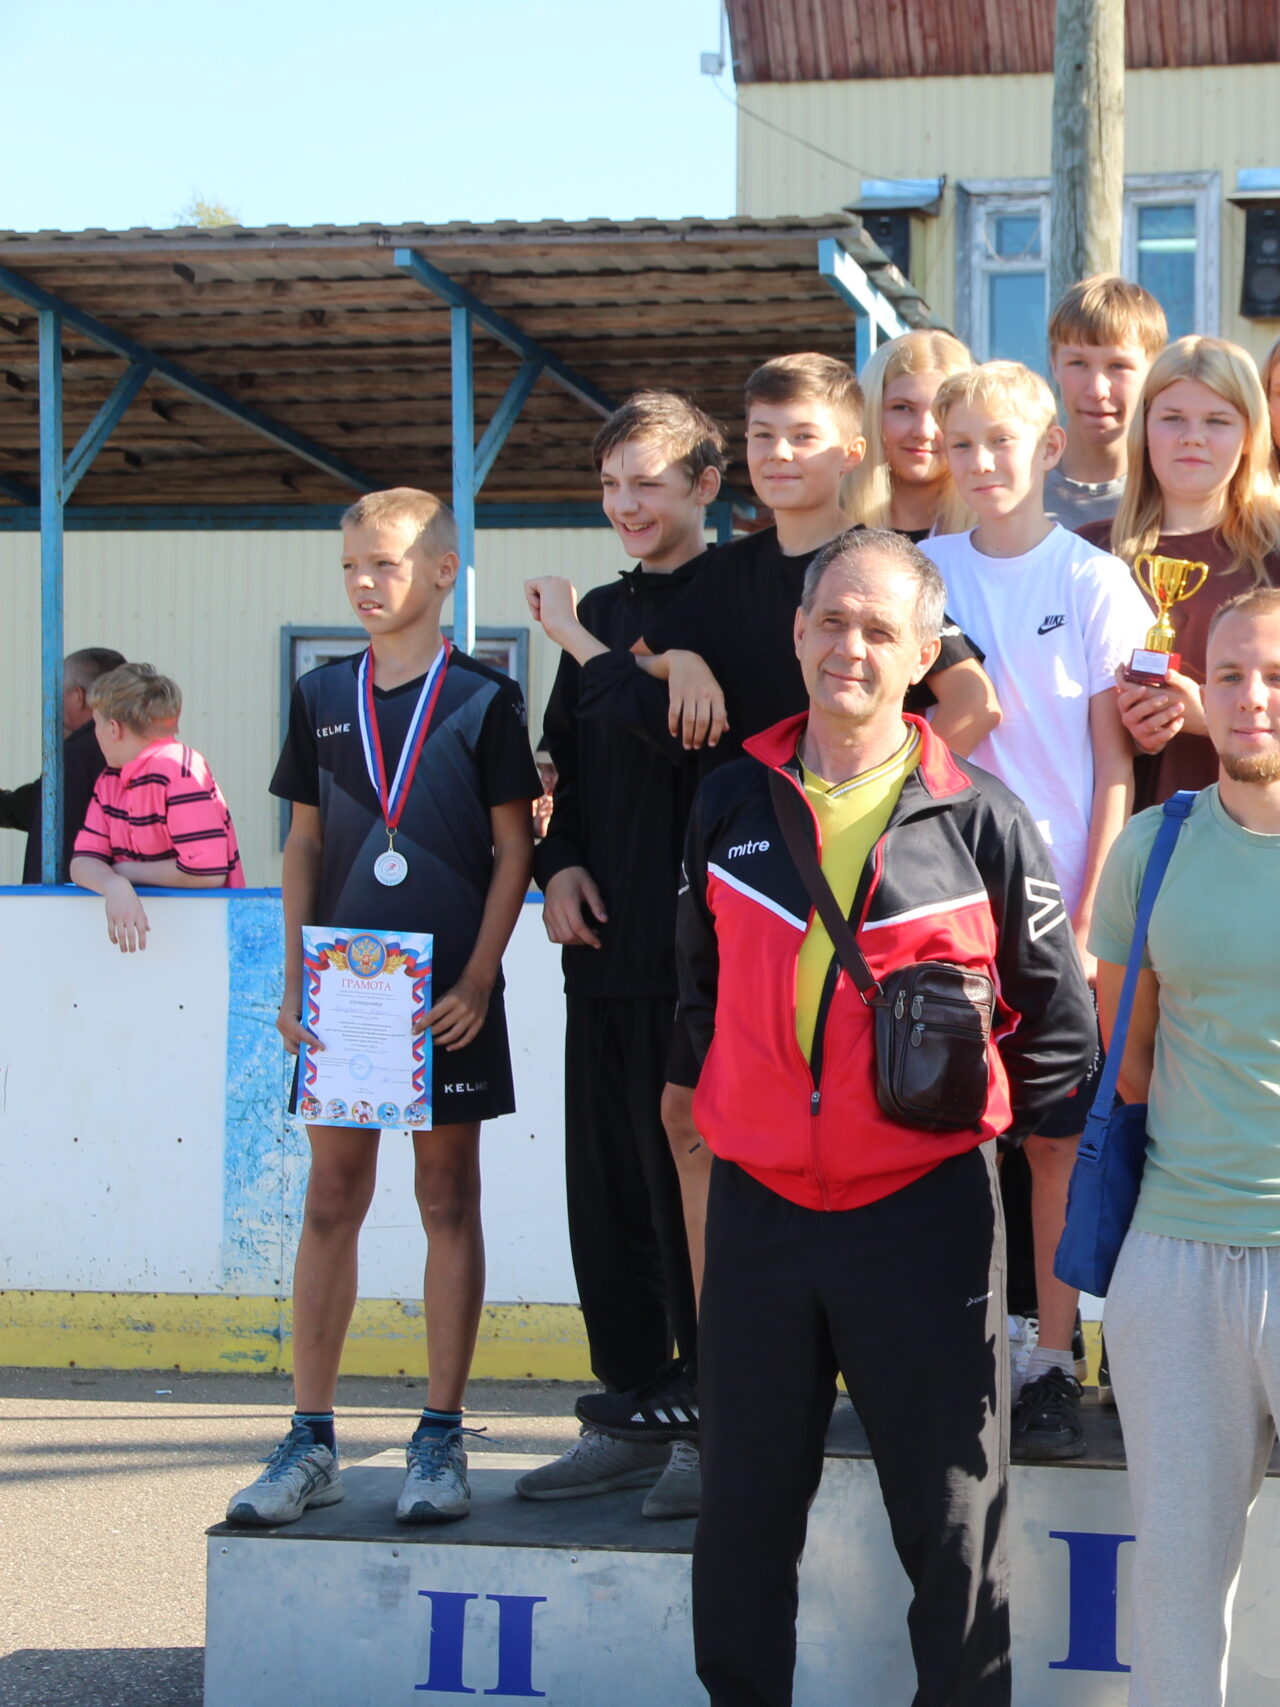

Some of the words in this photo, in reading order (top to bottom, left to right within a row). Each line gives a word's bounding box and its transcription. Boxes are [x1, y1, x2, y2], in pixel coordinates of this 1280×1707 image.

[1043, 614, 1067, 627] NIKE
[728, 840, 770, 860] mitre
[341, 978, 392, 992] ГРАМОТА
[414, 1590, 548, 1697] II
